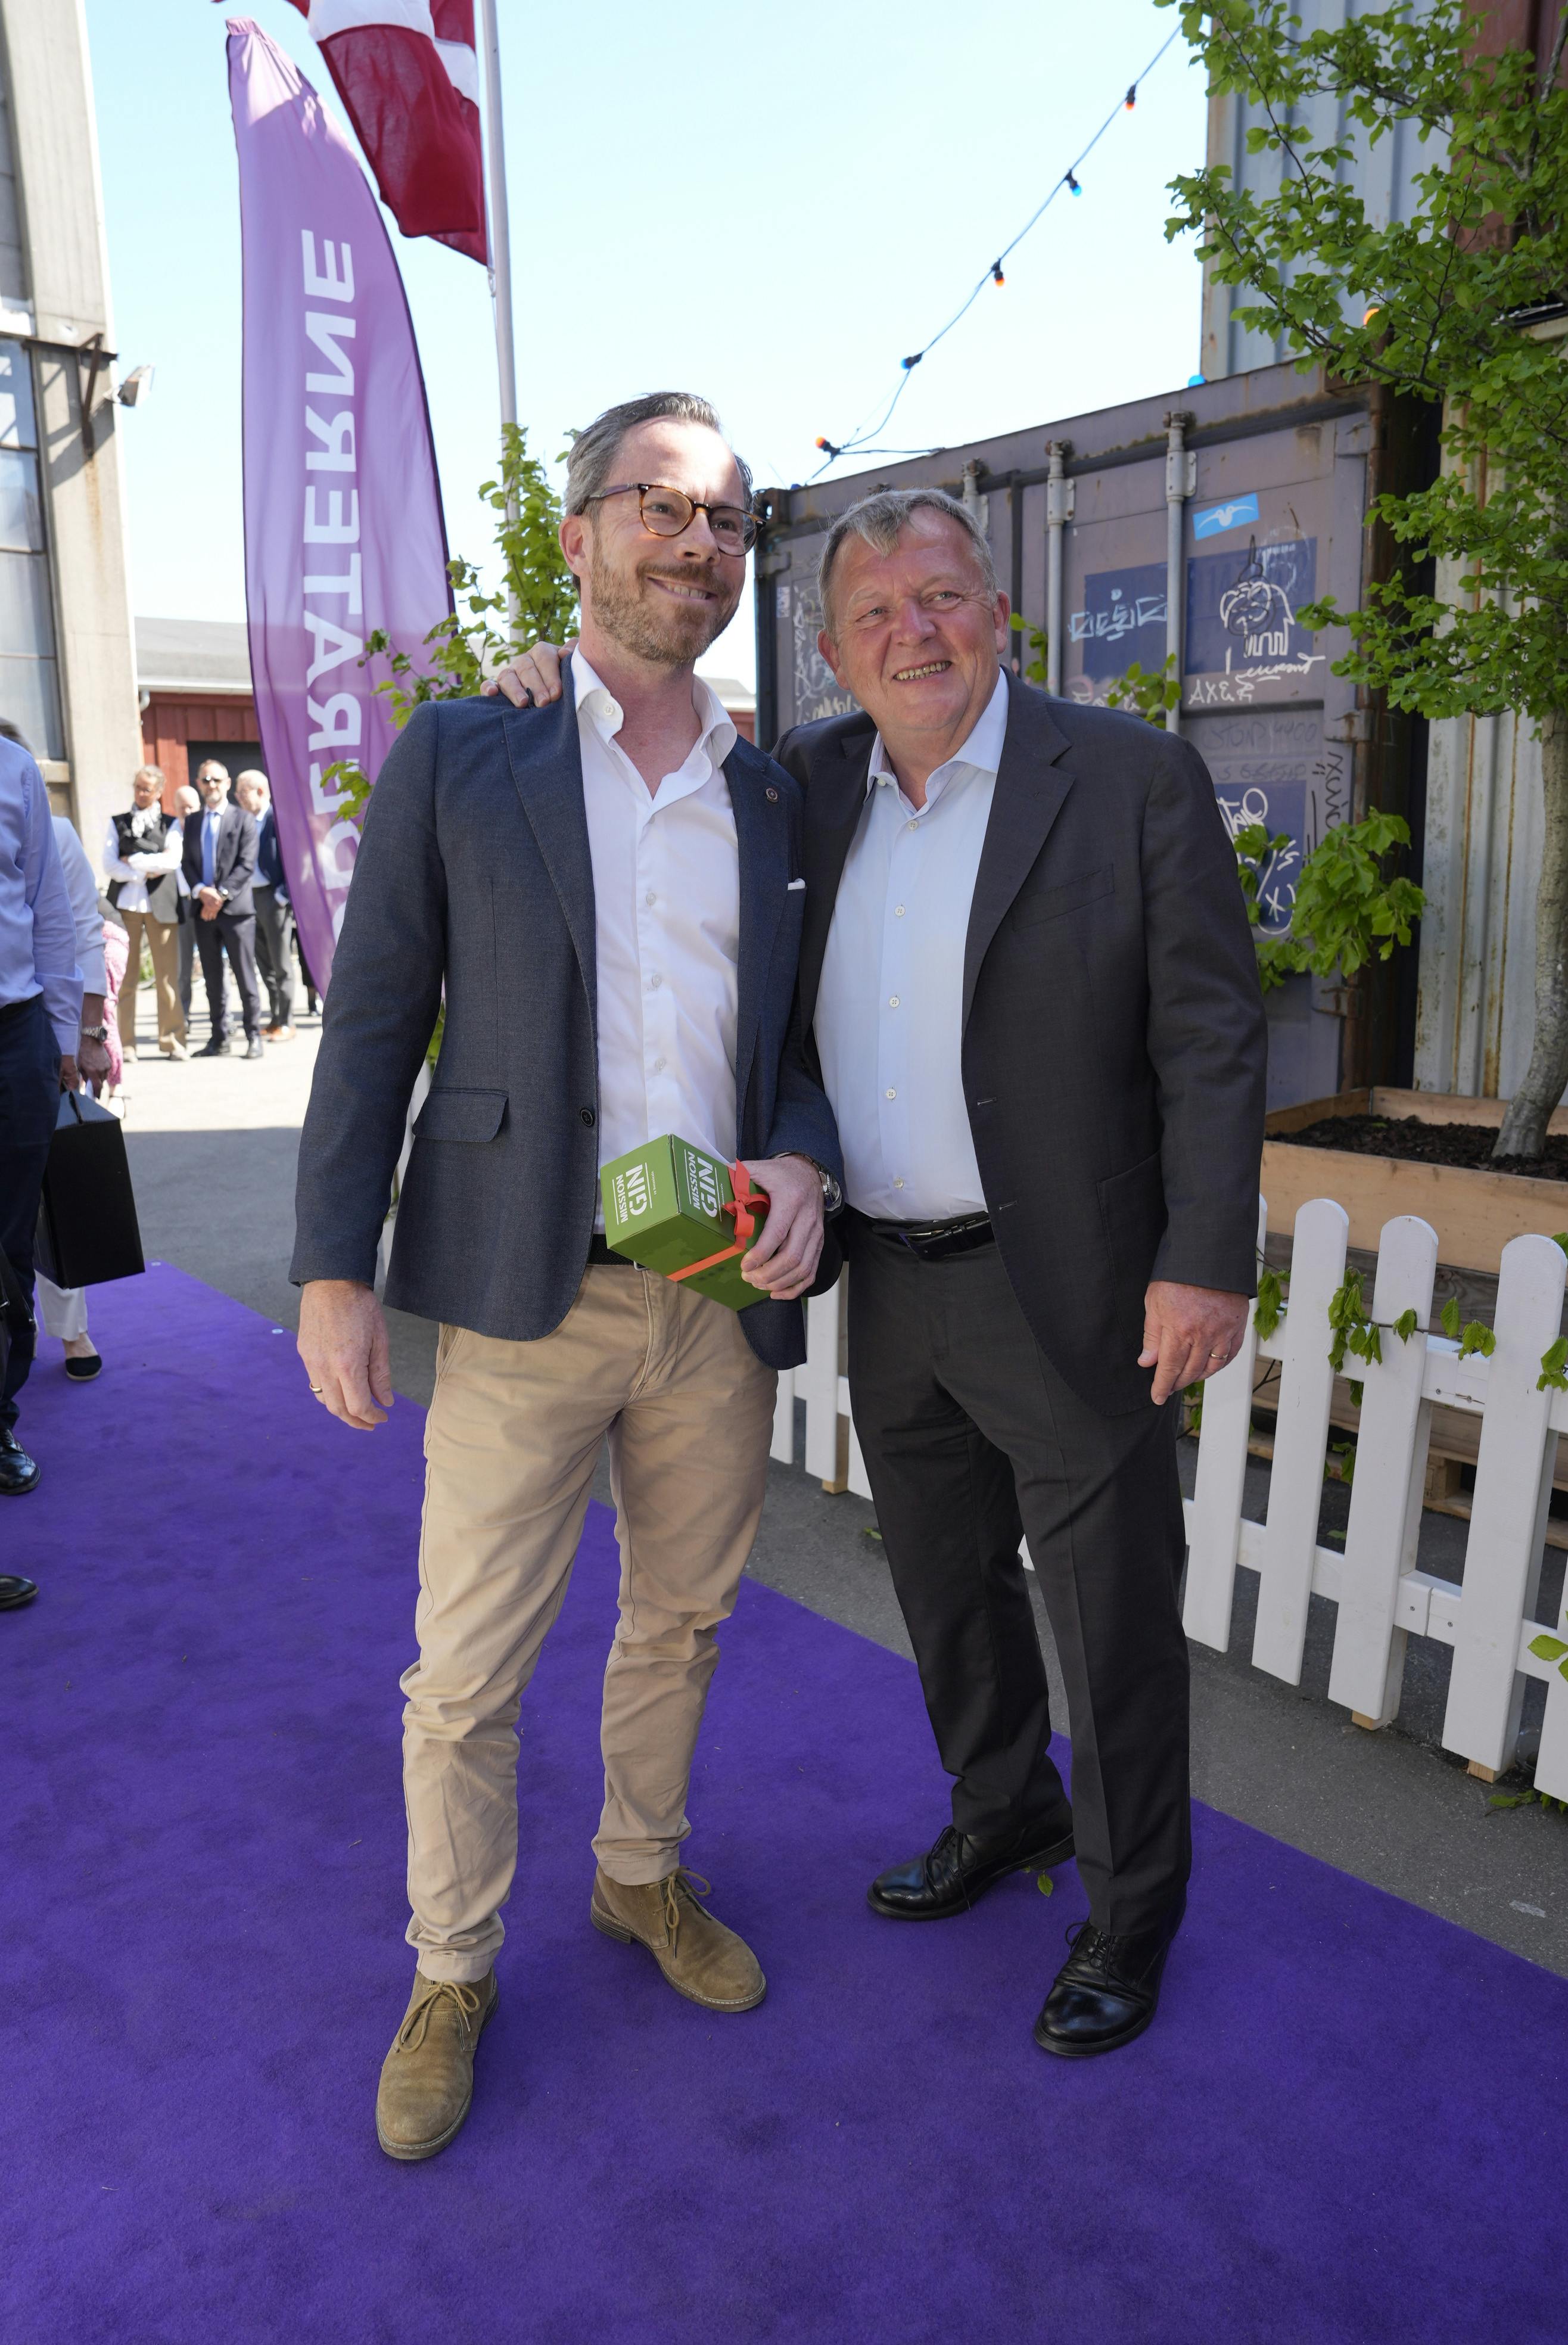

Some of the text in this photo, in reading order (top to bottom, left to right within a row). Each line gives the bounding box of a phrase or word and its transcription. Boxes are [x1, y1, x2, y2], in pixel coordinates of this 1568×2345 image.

[616, 1174, 629, 1223] MISSION
[626, 1164, 648, 1215] GIN
[688, 1151, 701, 1210] MISSION
[697, 1156, 717, 1217] GIN
